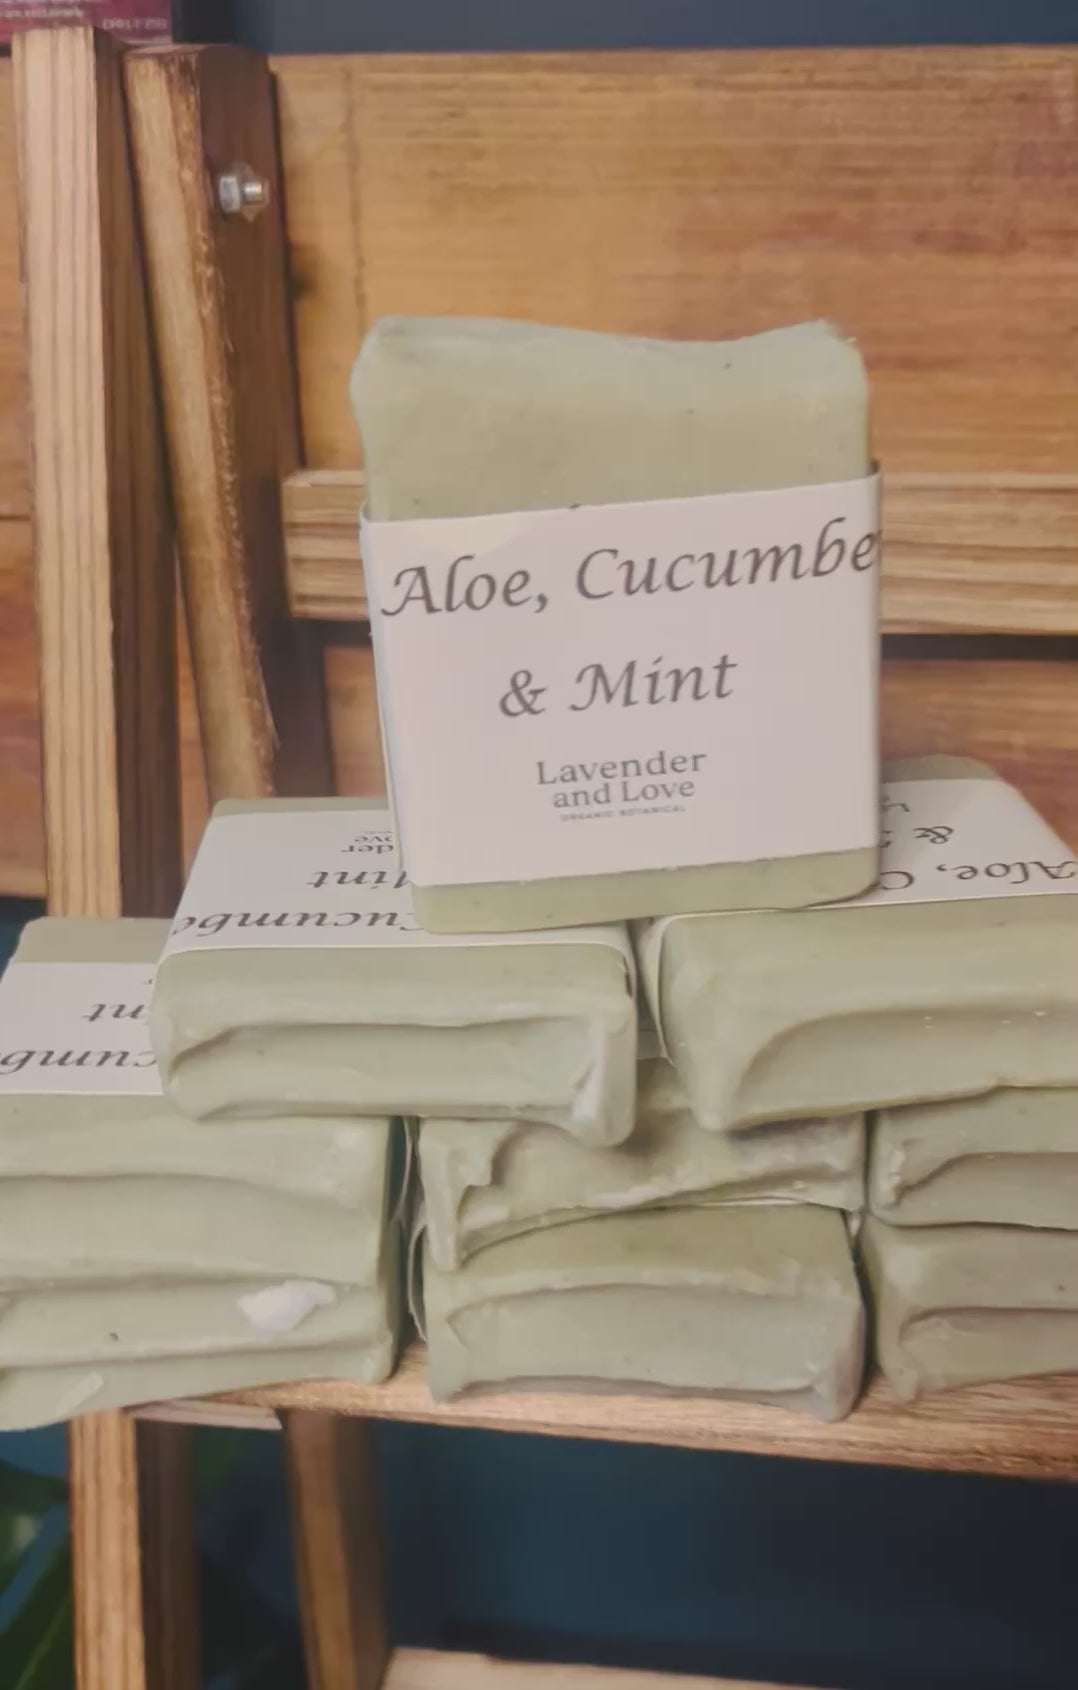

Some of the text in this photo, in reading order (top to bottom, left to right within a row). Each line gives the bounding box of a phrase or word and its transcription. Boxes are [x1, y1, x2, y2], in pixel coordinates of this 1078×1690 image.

[380, 516, 881, 617] Aloe, Cucumbe
[499, 653, 738, 717] & Mint
[536, 750, 708, 785] Lavender
[553, 780, 696, 809] and Love
[912, 825, 954, 845] &
[306, 869, 410, 890] int
[936, 861, 1078, 884] Aloe,
